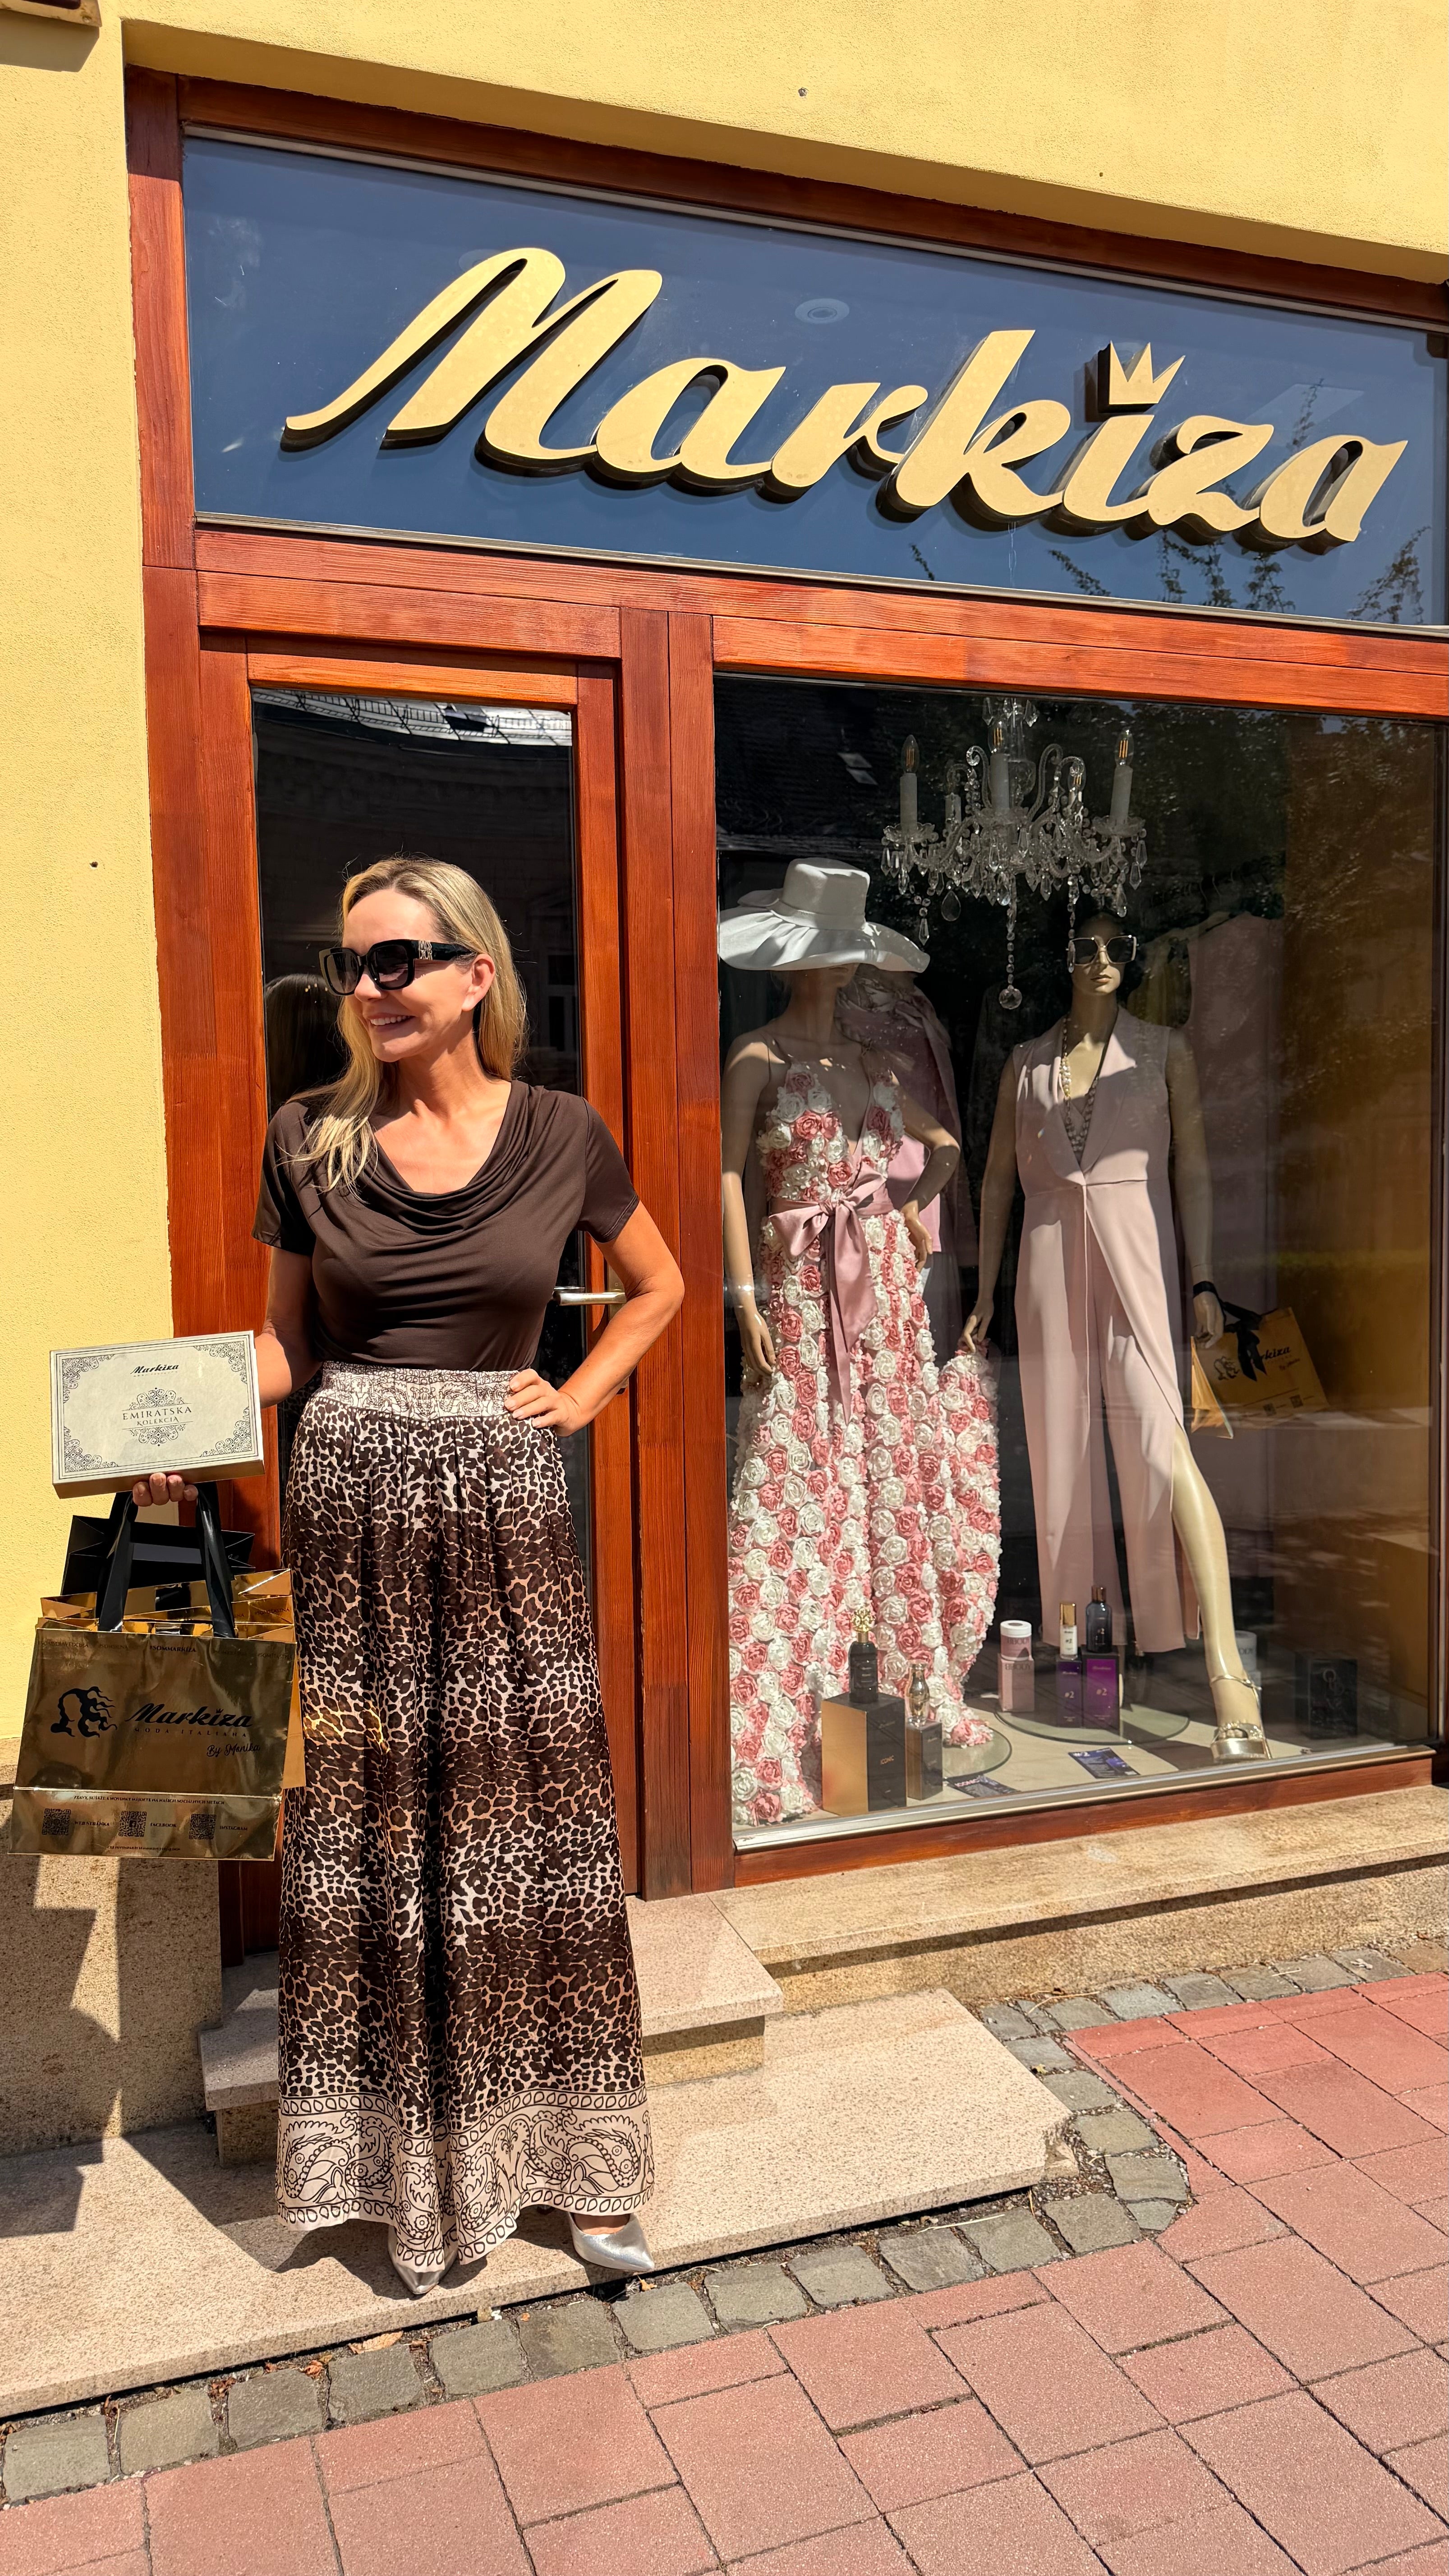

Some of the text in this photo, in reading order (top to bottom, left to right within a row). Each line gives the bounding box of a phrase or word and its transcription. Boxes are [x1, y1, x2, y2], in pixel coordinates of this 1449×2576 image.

[285, 247, 1407, 547] Markiza
[130, 1364, 179, 1375] Markiza
[123, 1406, 192, 1420] EMIRATSKA
[137, 1416, 179, 1426] KOLEKCIA
[124, 1703, 253, 1728] Markiza
[207, 1743, 261, 1757] By Monika
